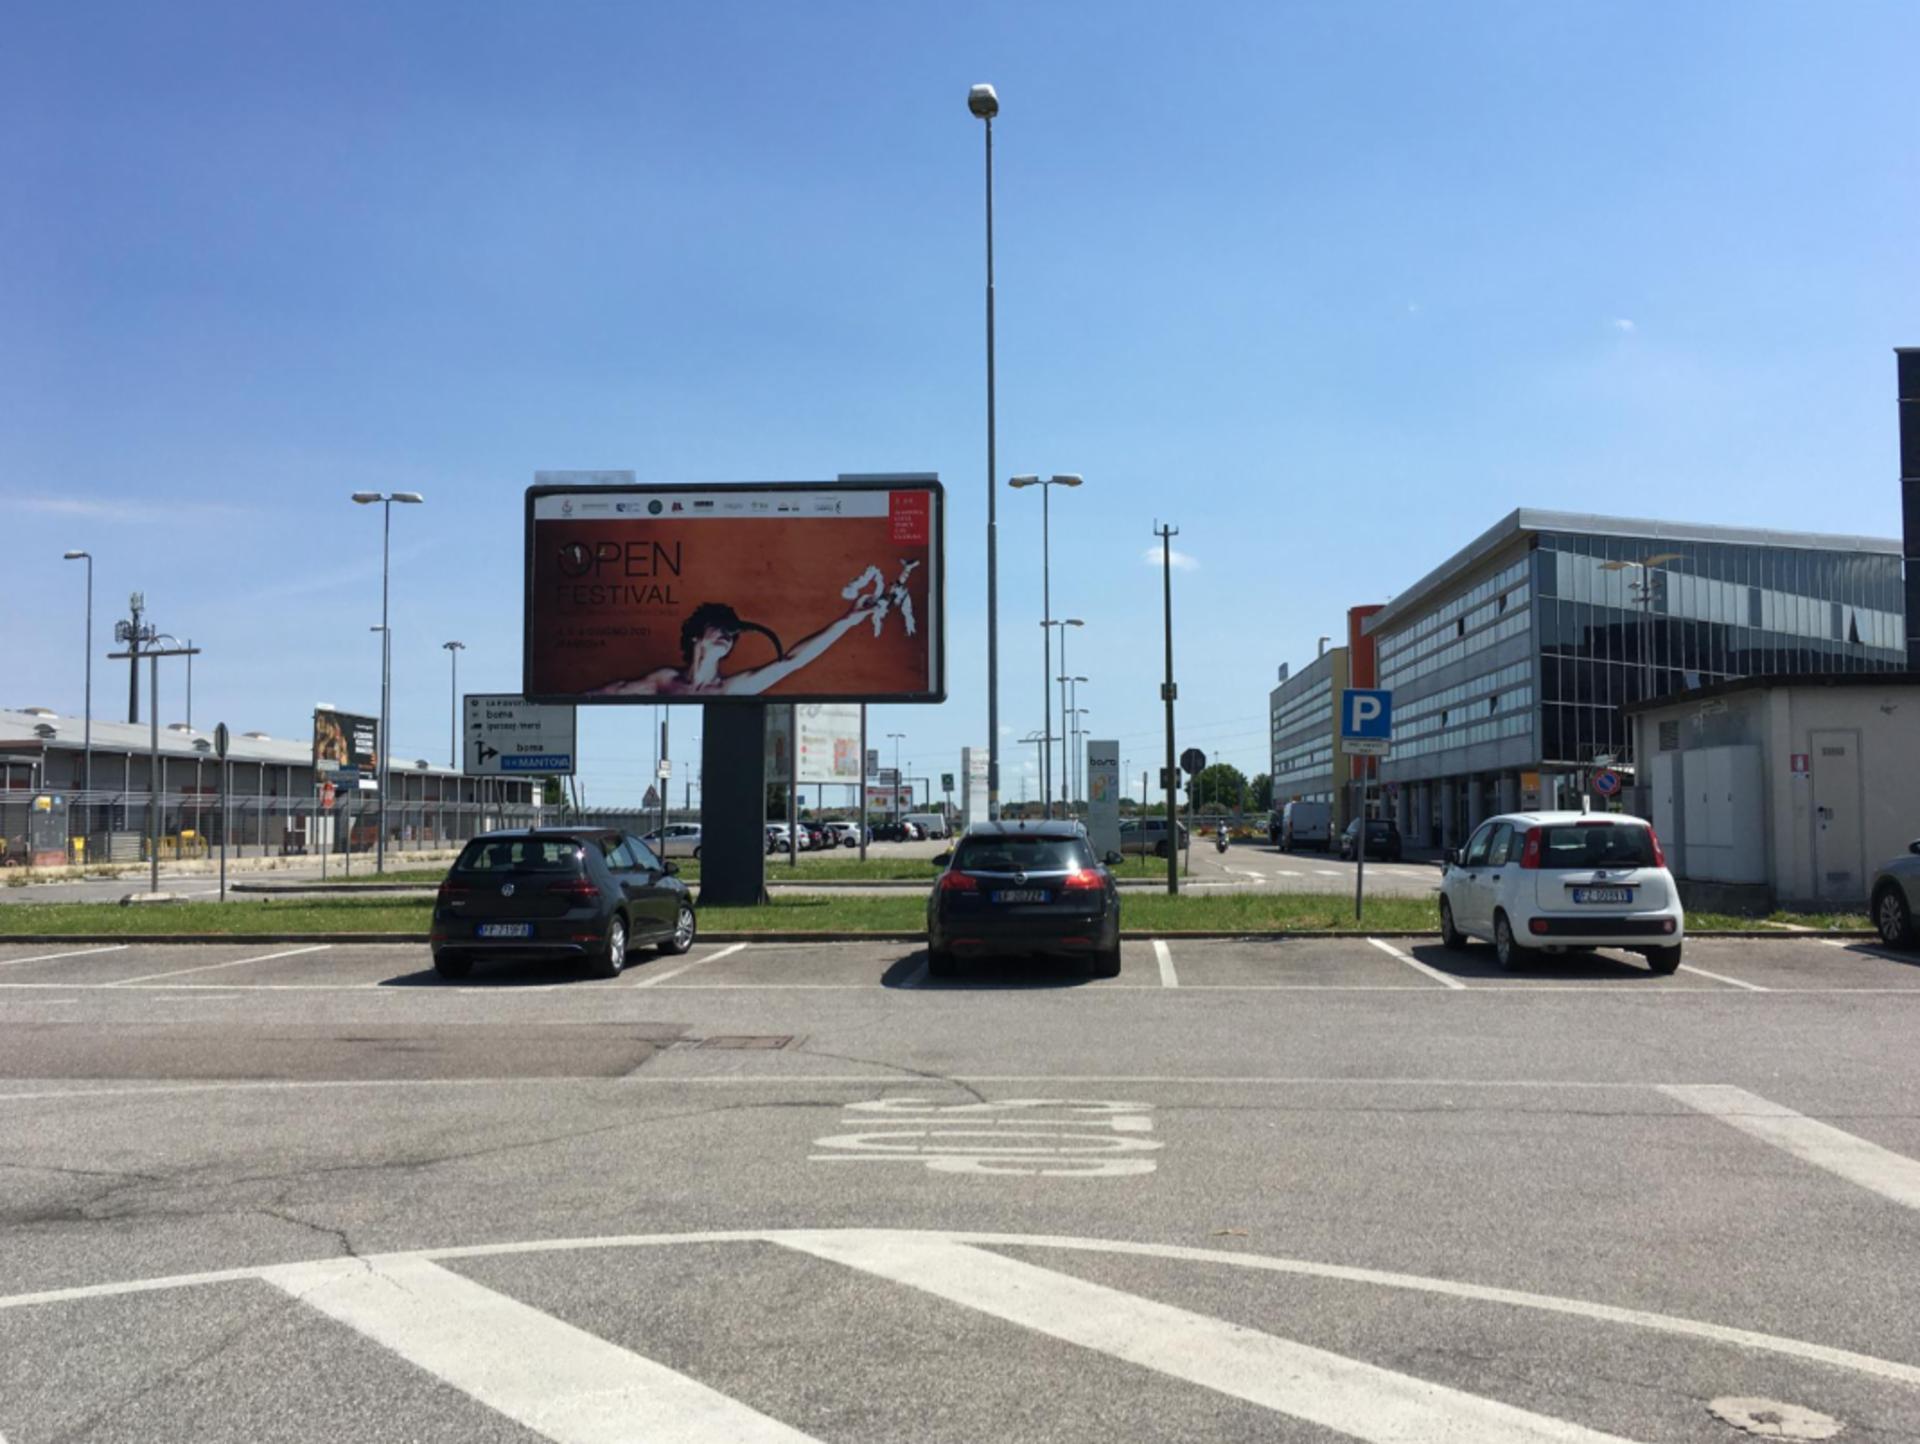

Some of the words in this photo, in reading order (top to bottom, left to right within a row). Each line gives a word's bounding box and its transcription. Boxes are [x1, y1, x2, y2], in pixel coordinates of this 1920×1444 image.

[558, 540, 682, 577] OPEN
[556, 584, 680, 605] FESTIVAL
[1352, 695, 1381, 731] P
